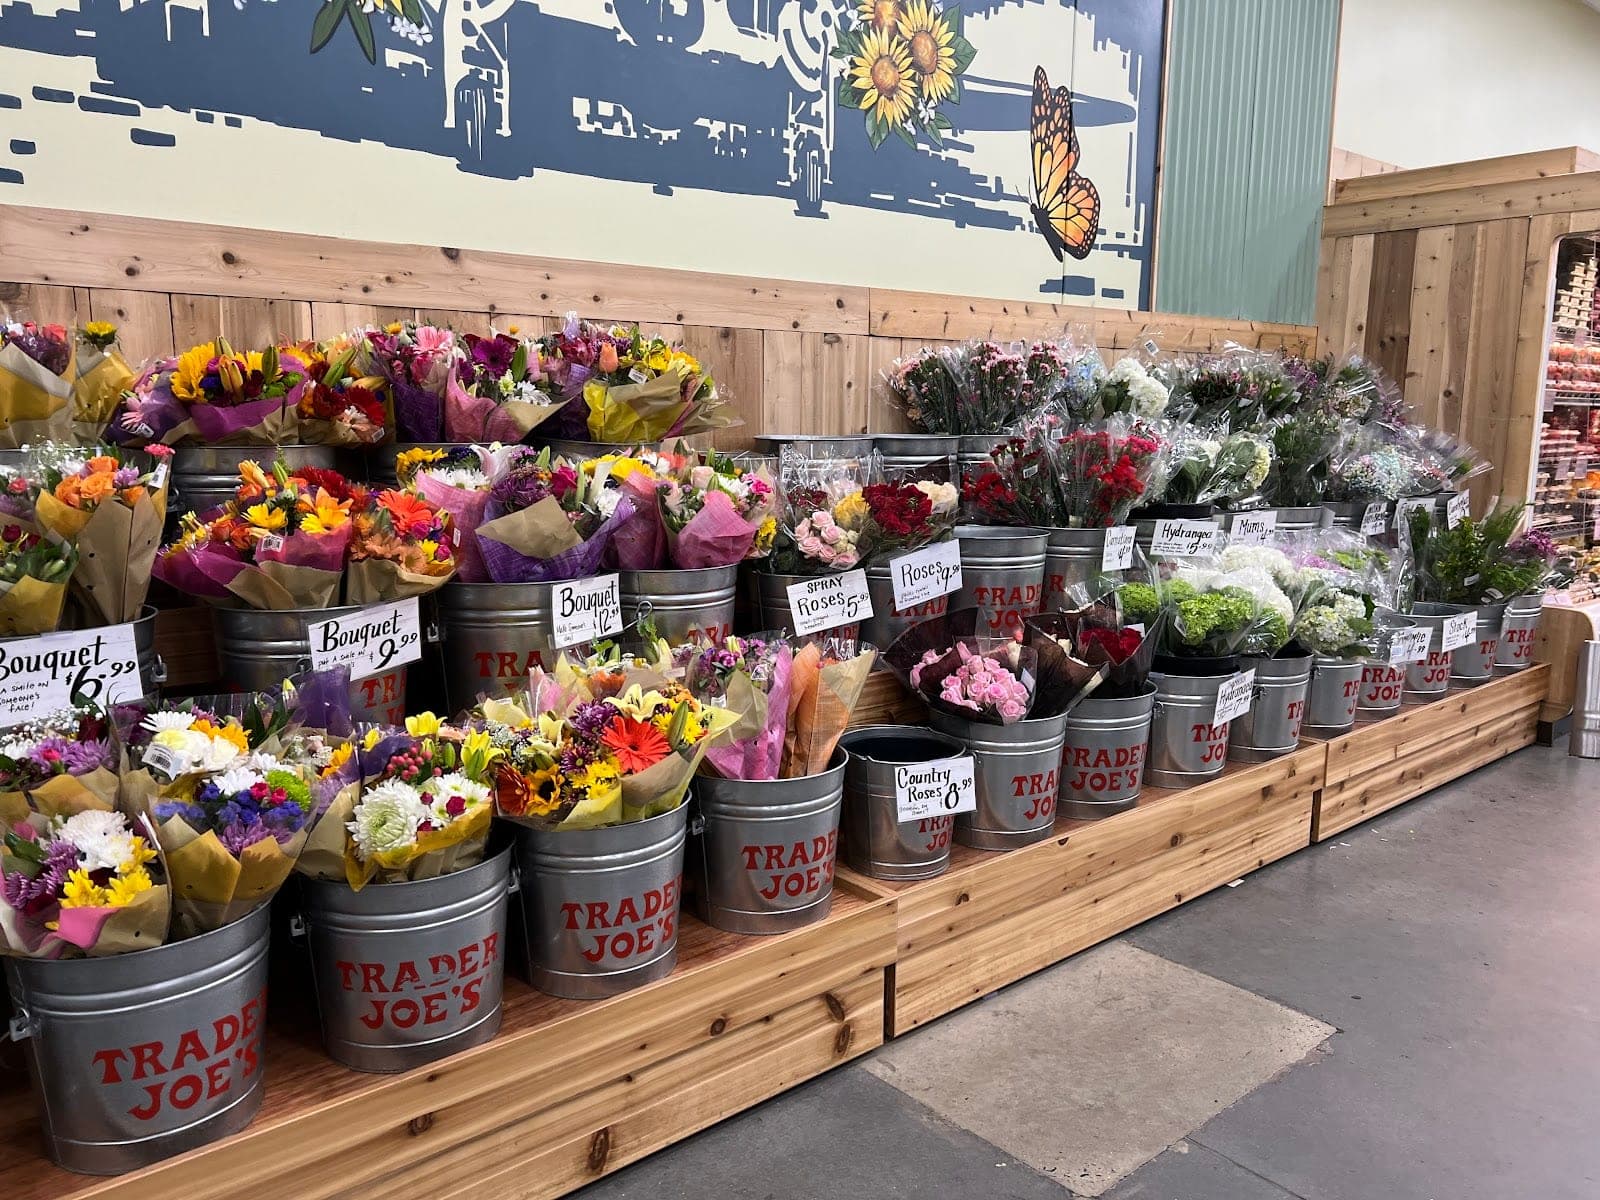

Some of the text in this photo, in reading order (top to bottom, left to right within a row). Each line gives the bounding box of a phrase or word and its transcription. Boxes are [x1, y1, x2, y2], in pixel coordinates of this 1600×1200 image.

[1162, 523, 1212, 541] Hydrangea
[1240, 520, 1264, 535] Mums
[807, 576, 843, 594] SPRAY
[902, 561, 942, 587] Roses
[560, 580, 616, 617] Bouquet
[798, 592, 845, 616] Roses
[317, 609, 403, 653] Bouquet
[369, 632, 418, 669] $9.99
[65, 660, 137, 706] $6.99
[898, 768, 951, 788] Country
[908, 786, 942, 802] Roses
[1069, 767, 1139, 792] JOE'S
[760, 858, 834, 899] JOE'S
[582, 911, 676, 962] JOE'S
[336, 932, 499, 993] TRADER
[360, 976, 483, 1030] JOE'S
[127, 1037, 260, 1120] JOE'S
